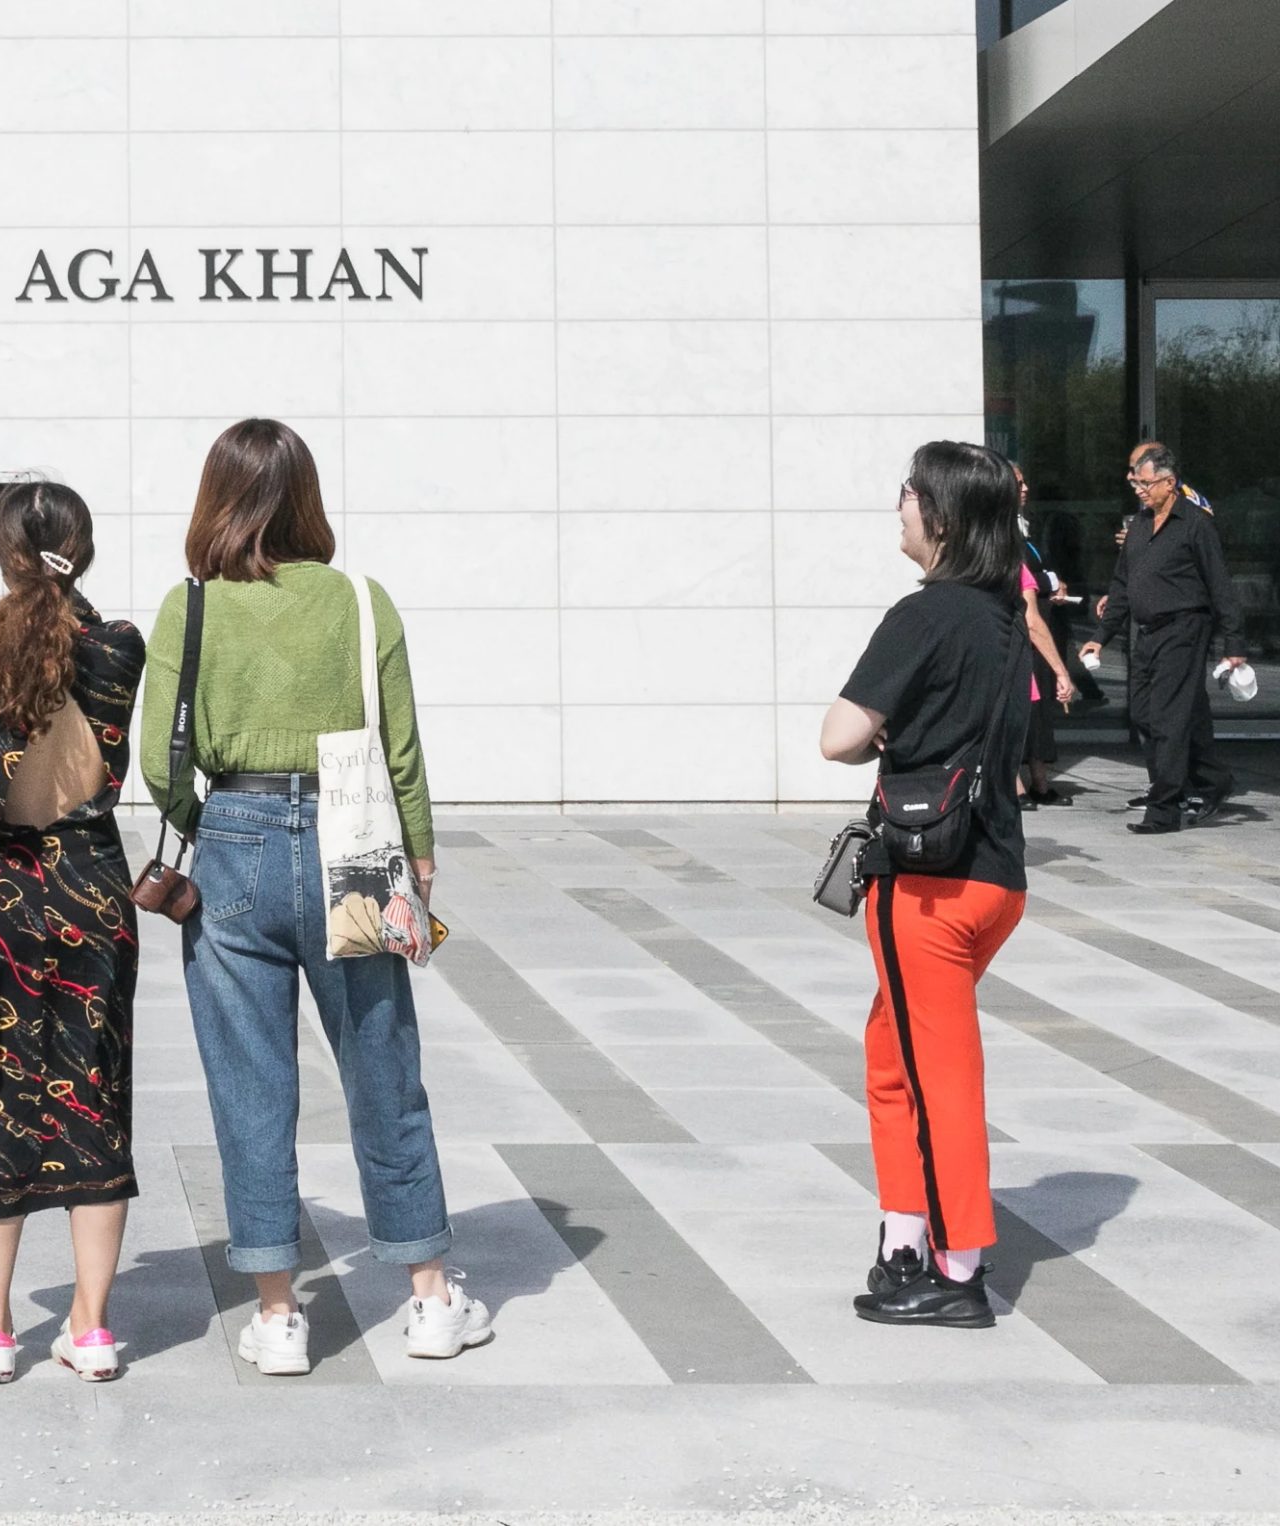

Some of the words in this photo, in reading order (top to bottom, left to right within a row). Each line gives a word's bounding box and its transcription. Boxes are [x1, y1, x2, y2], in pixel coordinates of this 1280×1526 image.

[15, 249, 173, 301] AGA
[198, 248, 428, 300] KHAN
[177, 701, 188, 732] SONY
[321, 747, 366, 774] Cyril
[325, 788, 361, 806] The
